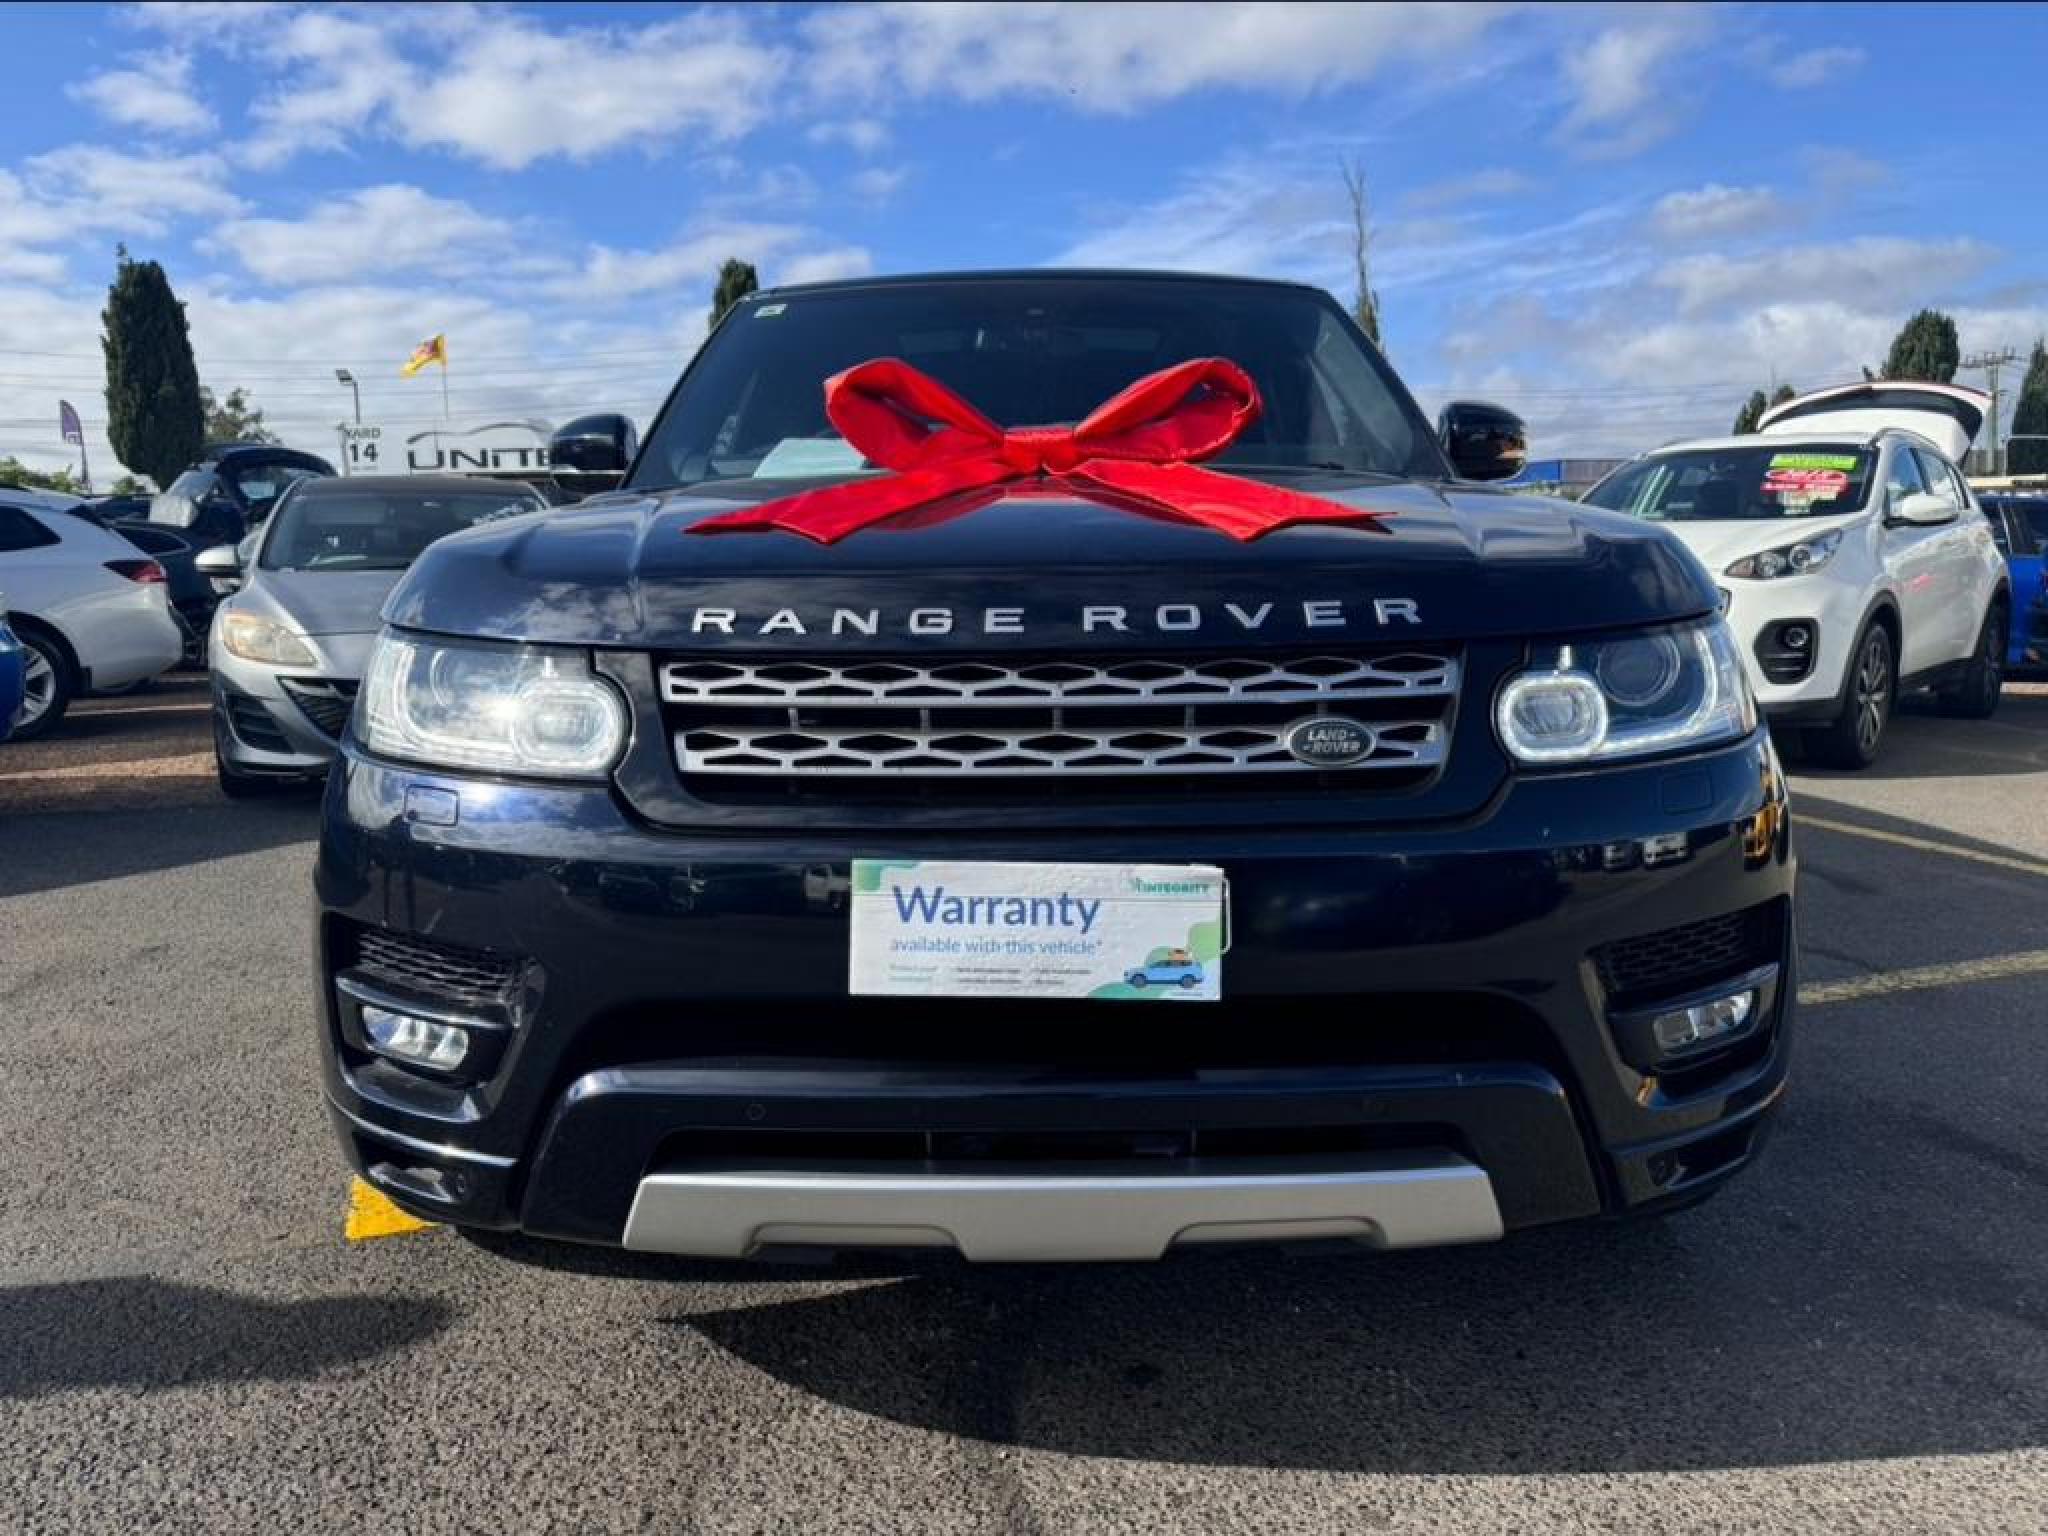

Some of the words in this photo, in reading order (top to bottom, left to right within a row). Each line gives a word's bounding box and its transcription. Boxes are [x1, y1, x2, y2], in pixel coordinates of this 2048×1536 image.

[349, 442, 379, 463] 14
[691, 607, 1026, 635] RANGE
[1083, 598, 1422, 632] ROVER
[1308, 729, 1347, 741] LAND
[1311, 741, 1361, 753] ROVER
[893, 885, 1101, 935] Warranty
[891, 936, 962, 954] available
[964, 937, 1002, 954] with
[1004, 937, 1036, 954] this
